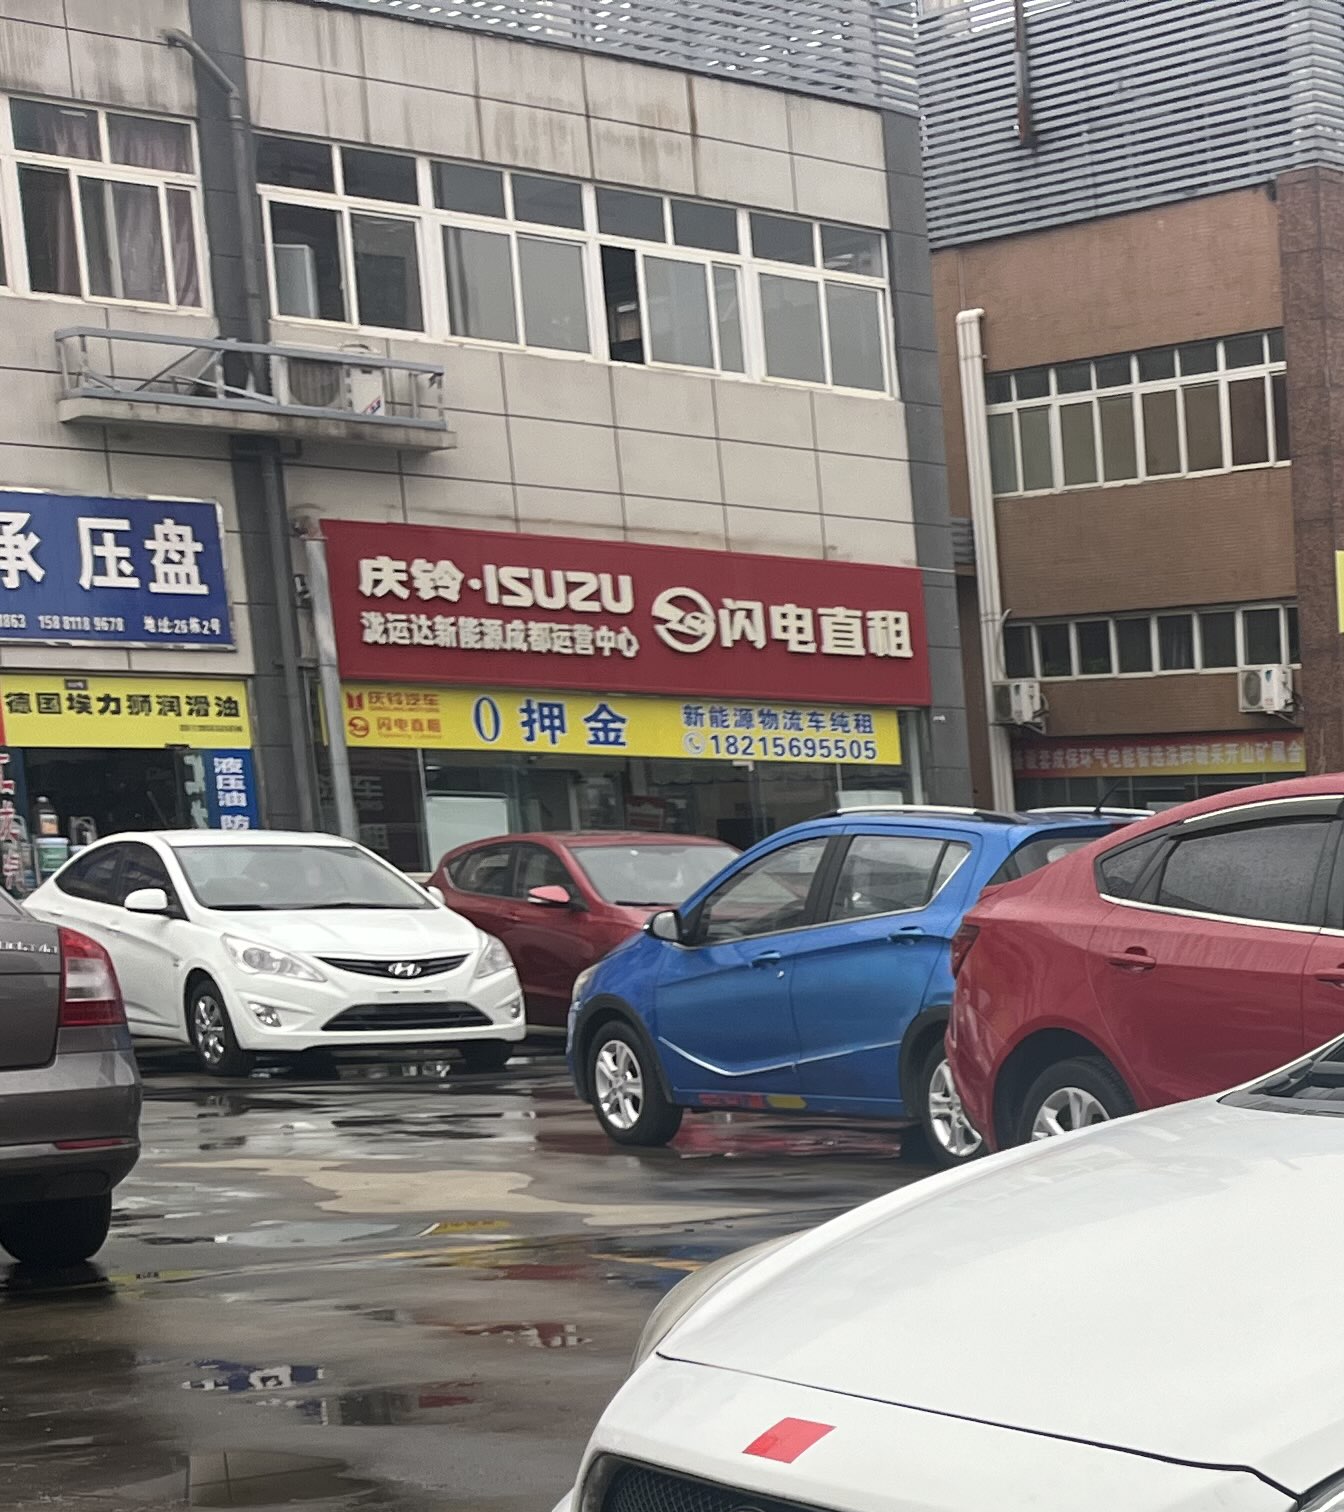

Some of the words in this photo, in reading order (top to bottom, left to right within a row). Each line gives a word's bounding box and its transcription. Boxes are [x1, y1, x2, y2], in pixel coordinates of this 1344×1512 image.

[78, 518, 209, 595] 压盘
[718, 597, 914, 659] 闪电直租
[5, 692, 241, 718] 德国埃力狮润滑油
[682, 704, 875, 735] 新能源物流车纯租
[710, 735, 877, 760] 18215695505
[213, 757, 248, 807] 液压油
